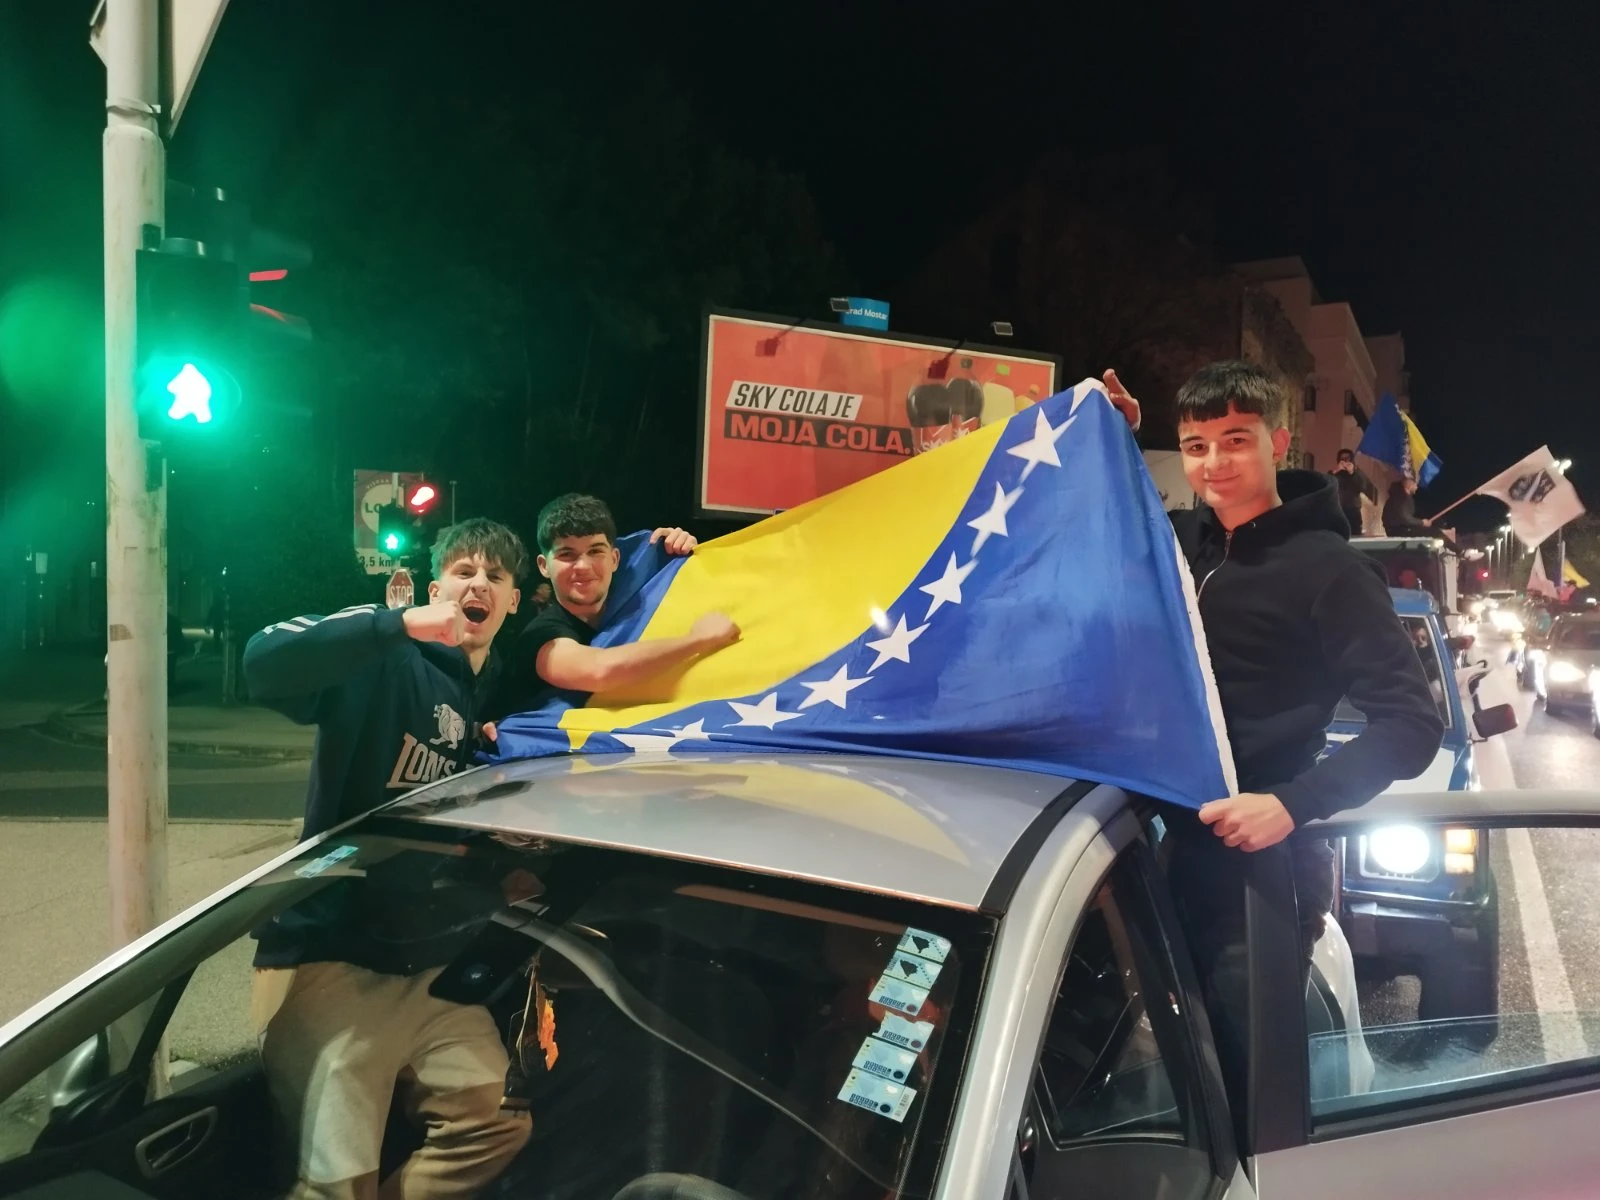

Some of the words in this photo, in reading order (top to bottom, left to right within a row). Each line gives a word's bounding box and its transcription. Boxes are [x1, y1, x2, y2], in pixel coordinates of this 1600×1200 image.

[734, 383, 777, 410] SKY
[779, 388, 826, 416] COLA
[831, 396, 854, 418] JE
[731, 413, 818, 446] MOJA
[825, 424, 910, 455] COLA.
[390, 585, 412, 605] STOP
[386, 732, 457, 788] LONS
